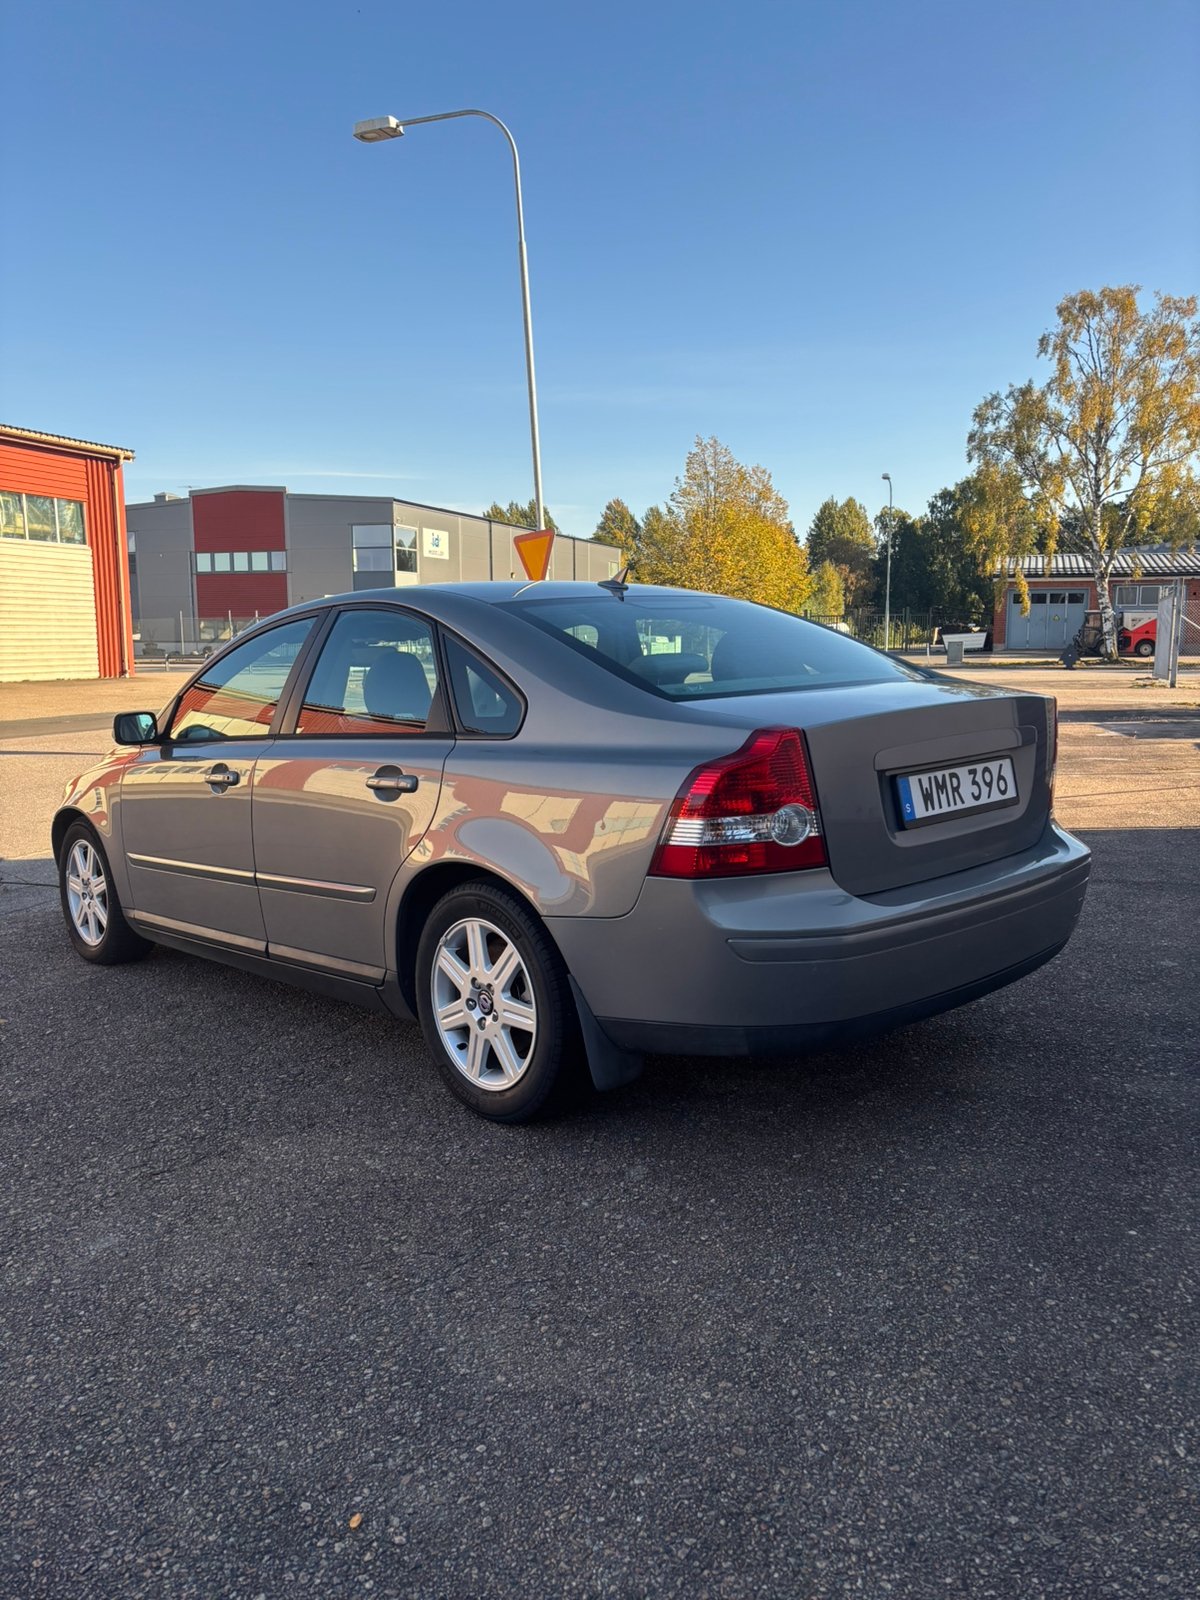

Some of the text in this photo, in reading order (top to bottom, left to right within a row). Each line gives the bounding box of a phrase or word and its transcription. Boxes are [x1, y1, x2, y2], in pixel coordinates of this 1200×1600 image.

[918, 764, 1008, 812] WMR 396
[905, 803, 912, 813] S
[479, 901, 520, 938] MICHELIN
